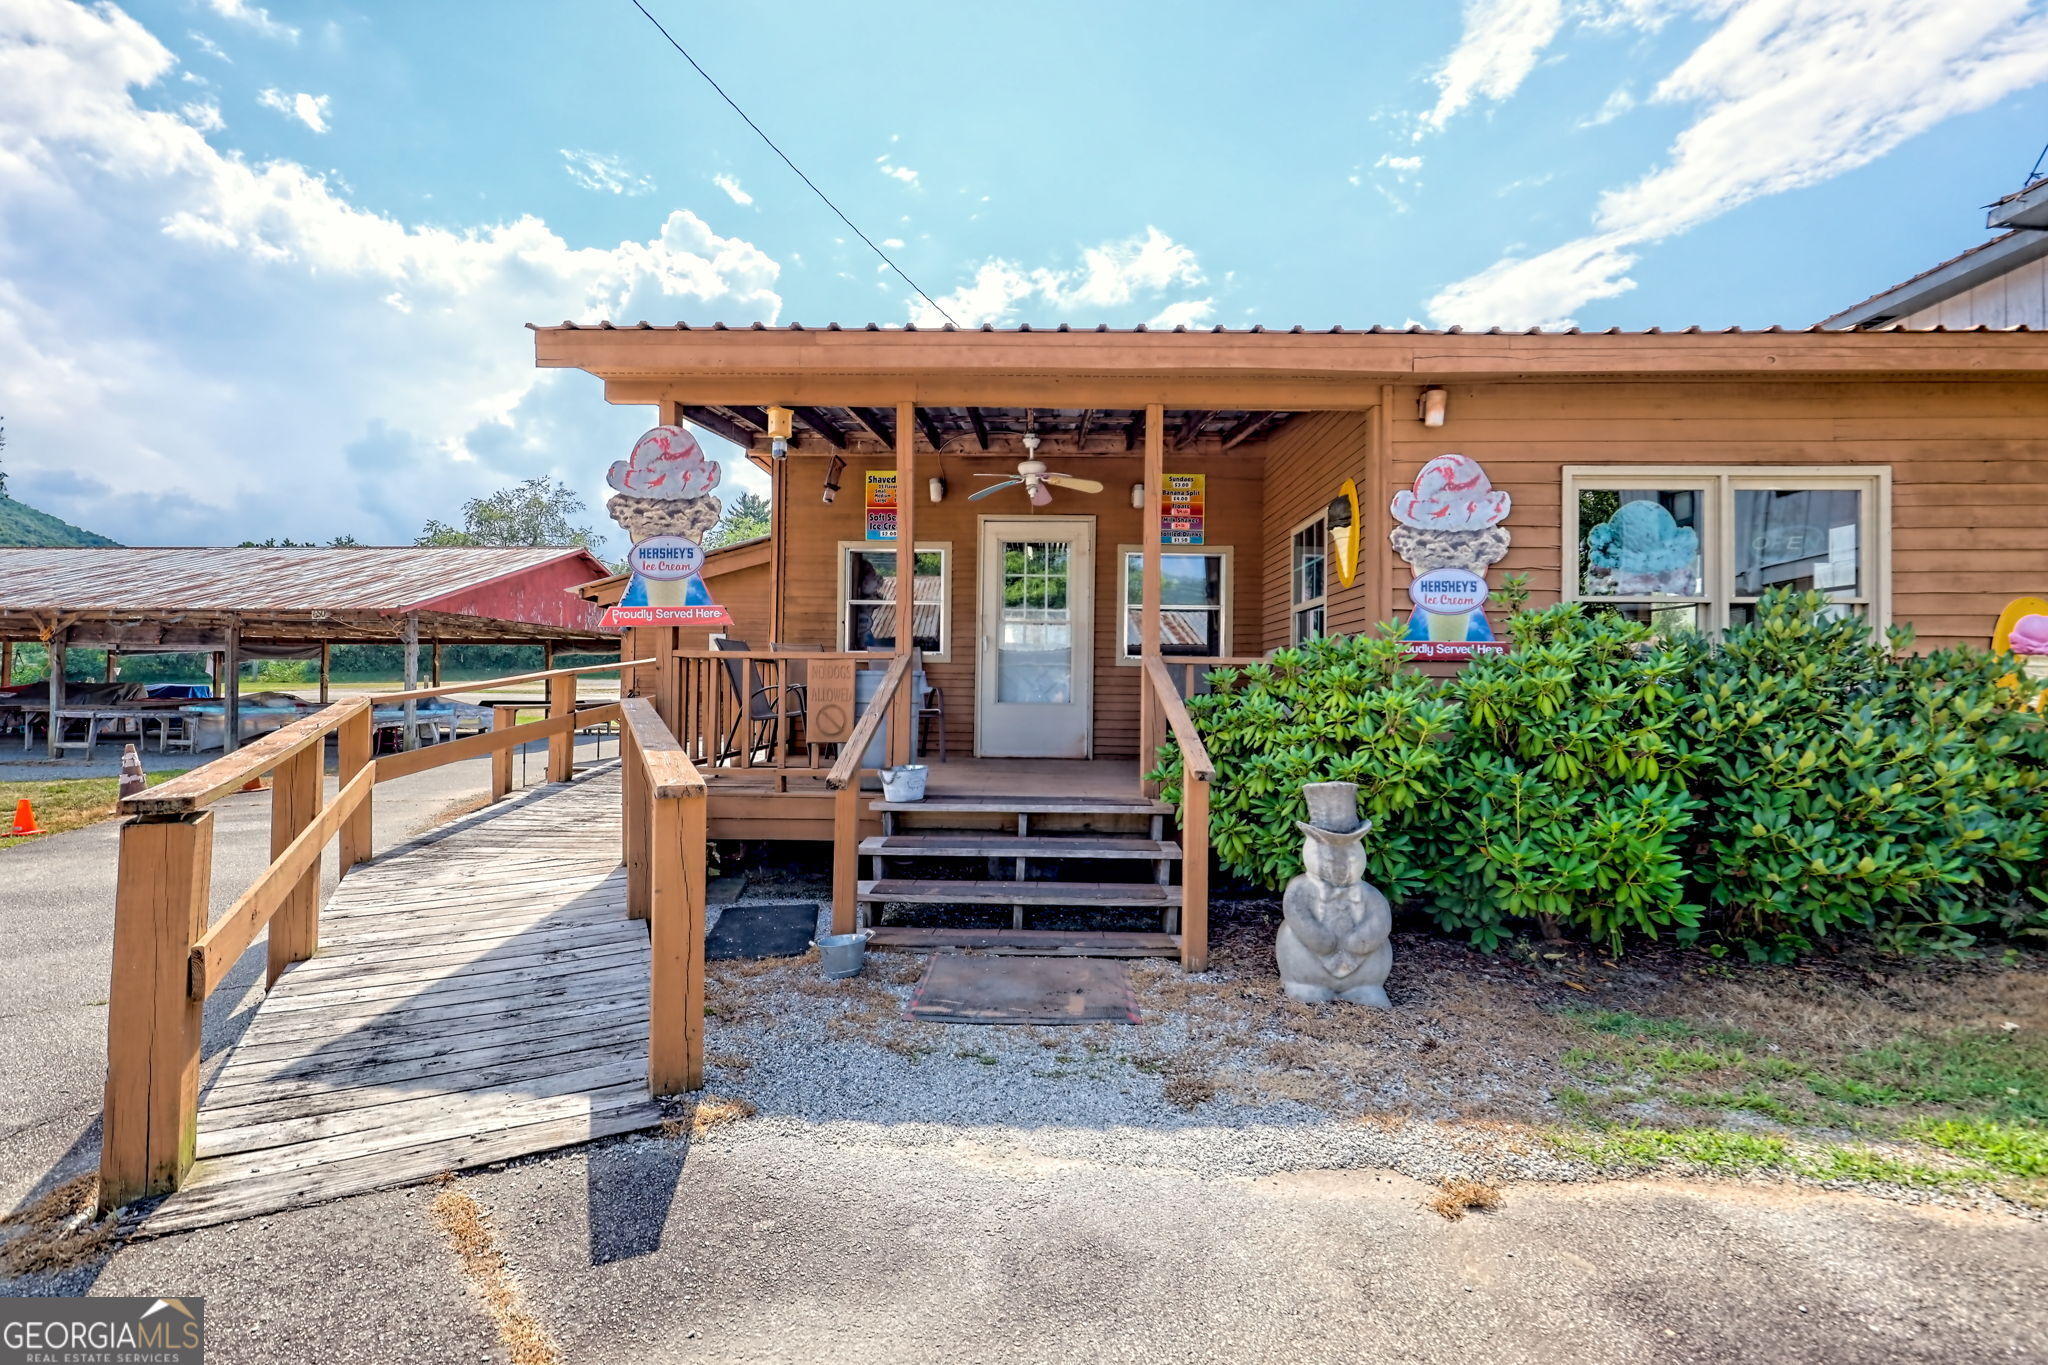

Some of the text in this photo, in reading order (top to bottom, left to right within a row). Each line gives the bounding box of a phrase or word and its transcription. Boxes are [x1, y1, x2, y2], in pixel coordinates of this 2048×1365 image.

[868, 475, 897, 484] Shaved
[869, 513, 885, 521] Soft
[869, 523, 897, 531] Ice Cre
[639, 547, 694, 559] HERSHEY'S
[643, 560, 692, 571] Ice Cream
[1420, 580, 1477, 593] HERSHEY'S
[1424, 594, 1474, 605] Ice Cream
[612, 609, 721, 621] Proudly Served Here
[812, 665, 852, 680] NO DOGS
[811, 687, 853, 702] ALLOWED
